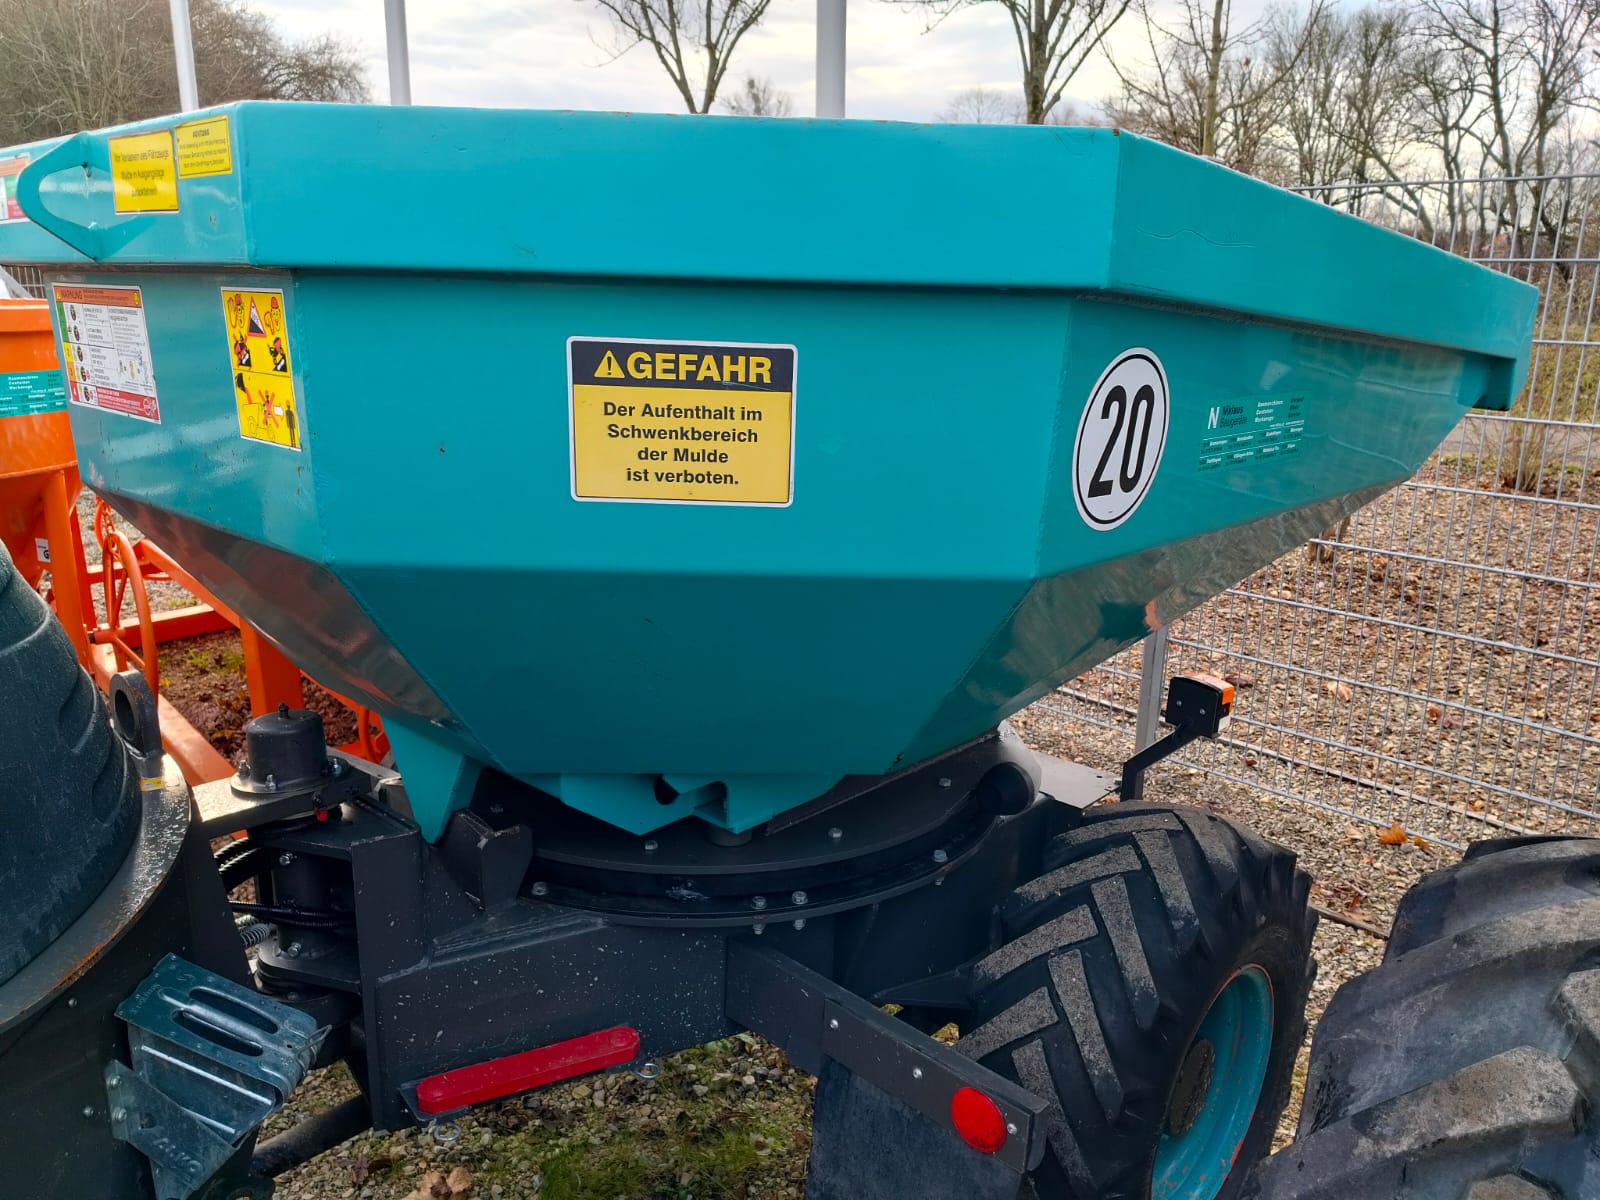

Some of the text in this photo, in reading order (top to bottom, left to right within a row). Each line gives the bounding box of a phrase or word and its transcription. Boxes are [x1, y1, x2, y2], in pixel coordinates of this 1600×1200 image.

[626, 351, 772, 384] GEFAHR
[603, 401, 763, 421] Der Aufenthalt im
[1222, 405, 1244, 416] Niklaus
[607, 423, 758, 443] Schwenkbereich
[1087, 384, 1155, 499] 20
[637, 447, 729, 463] der Mulde
[626, 467, 739, 485] ist verboten.
